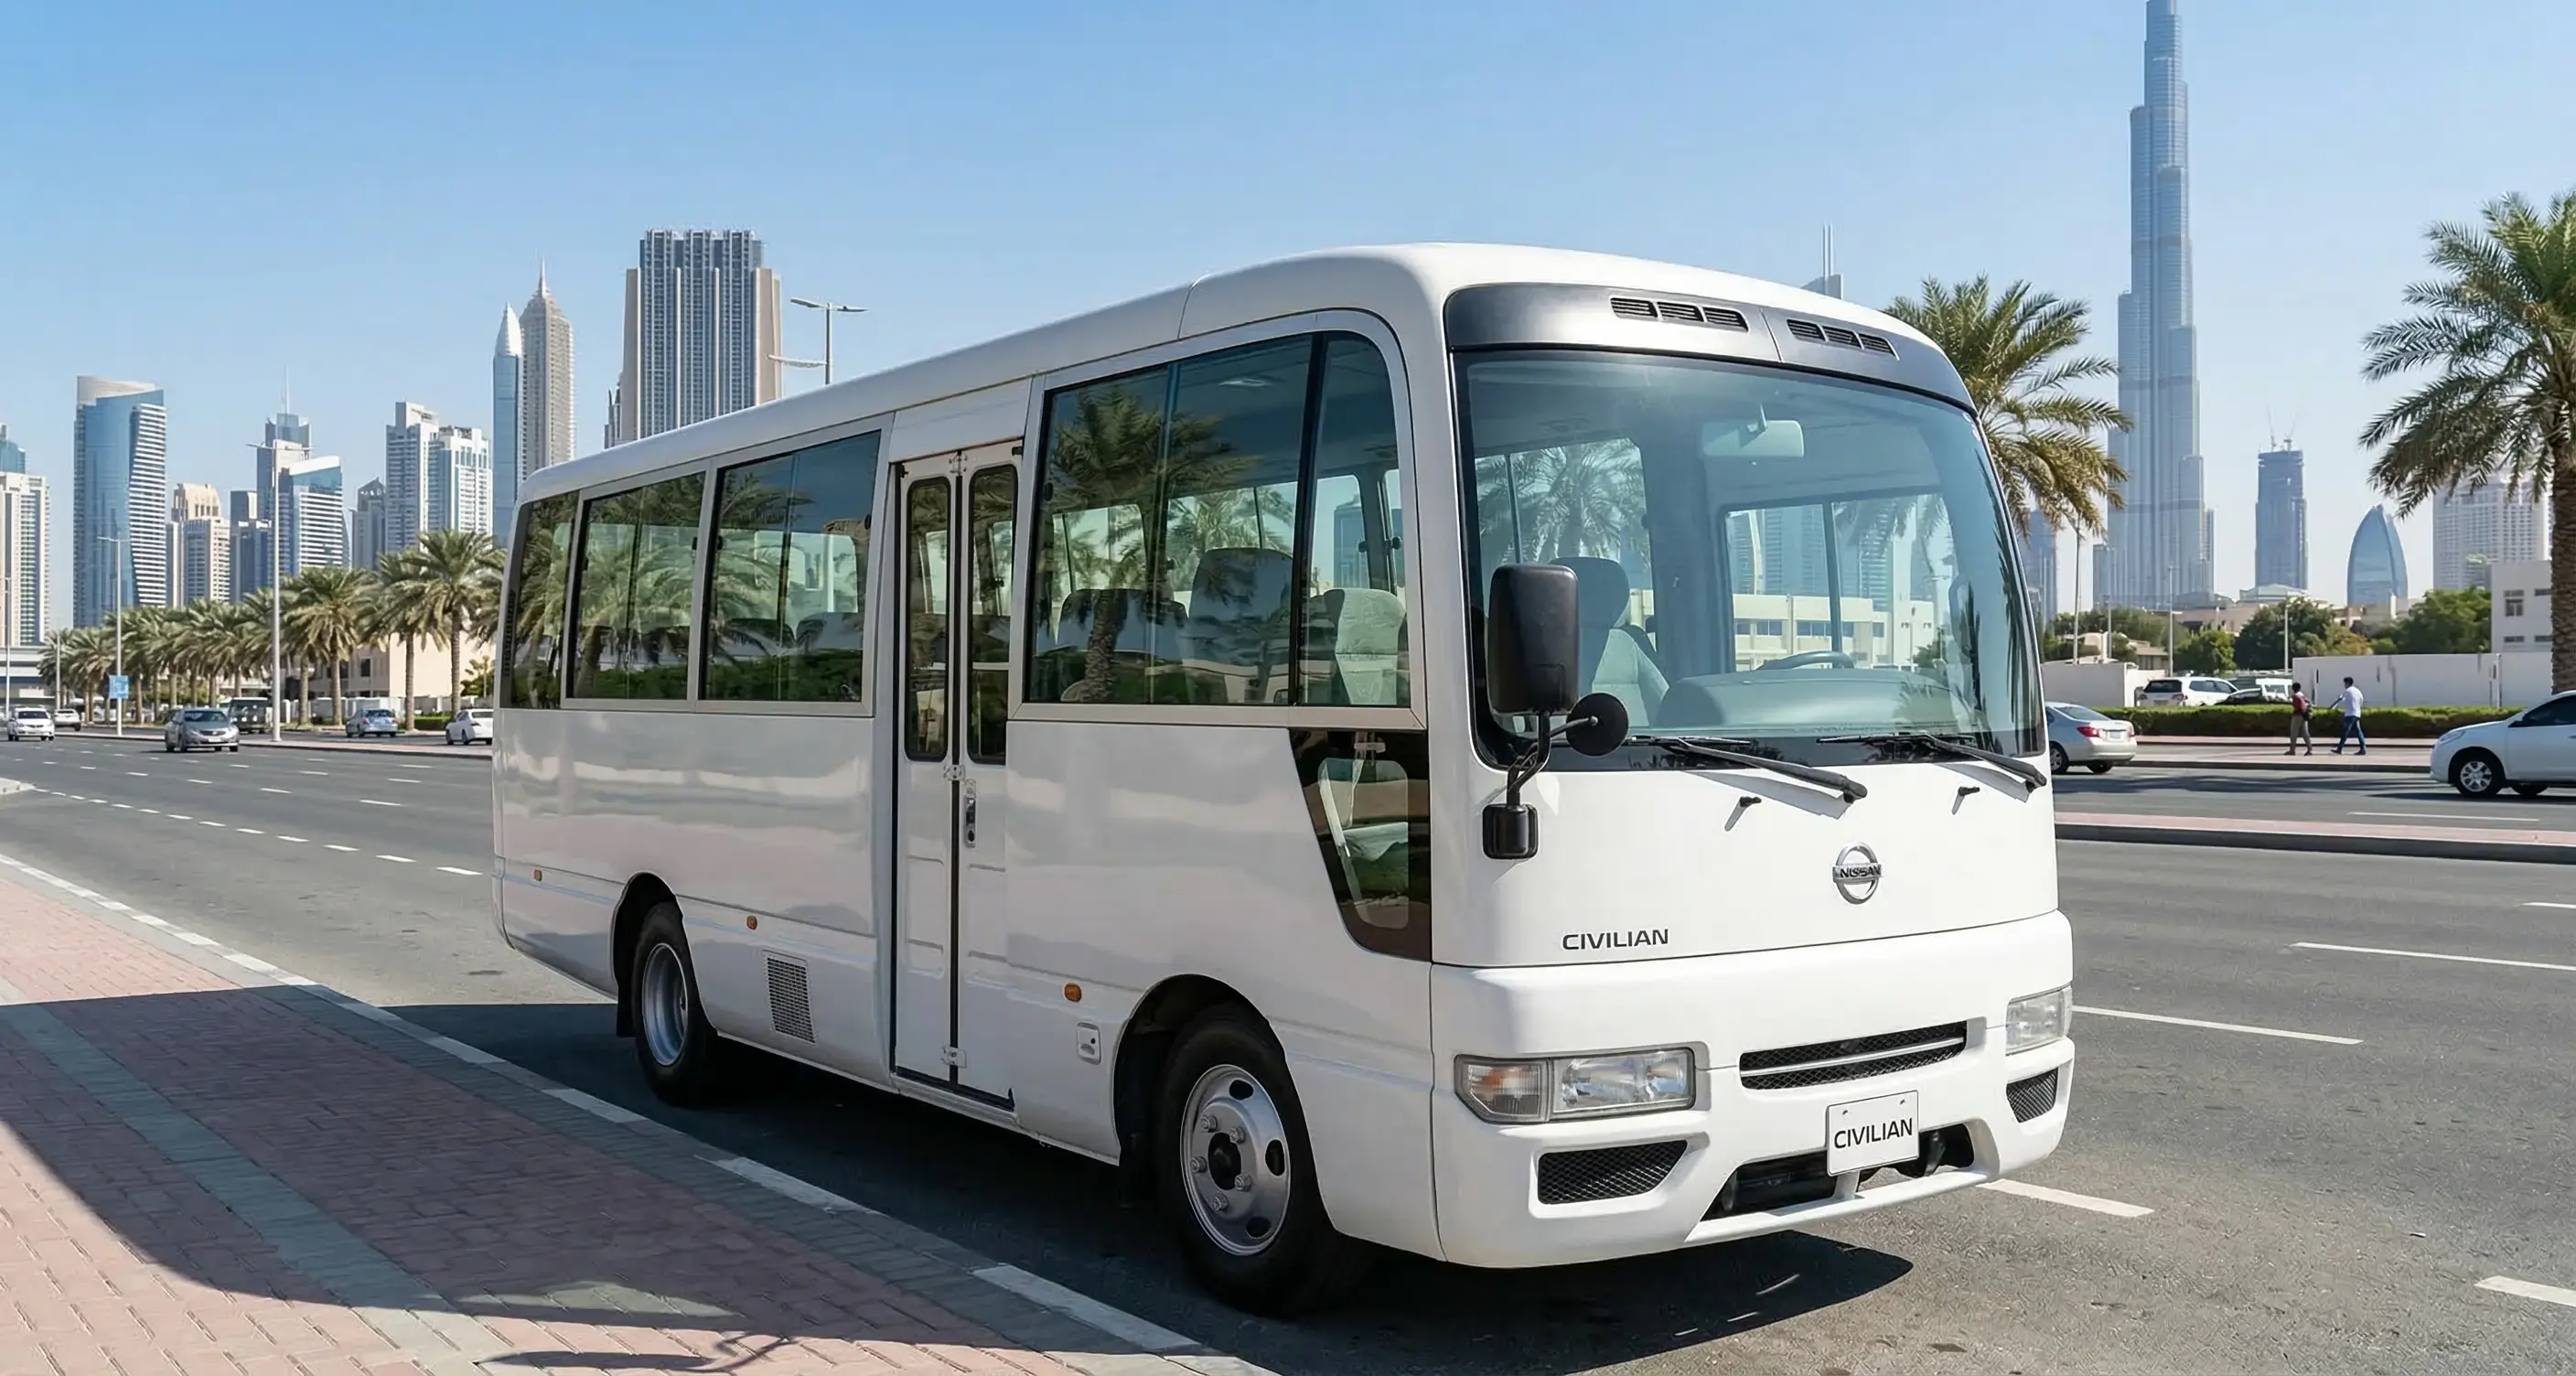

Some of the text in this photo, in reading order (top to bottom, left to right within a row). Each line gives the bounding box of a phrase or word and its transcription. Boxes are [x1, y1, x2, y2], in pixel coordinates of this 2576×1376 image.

[1840, 865, 1881, 878] NISSAN
[1562, 929, 1669, 951] CIVILIAN
[1834, 1118, 1912, 1149] CIVILIAN
